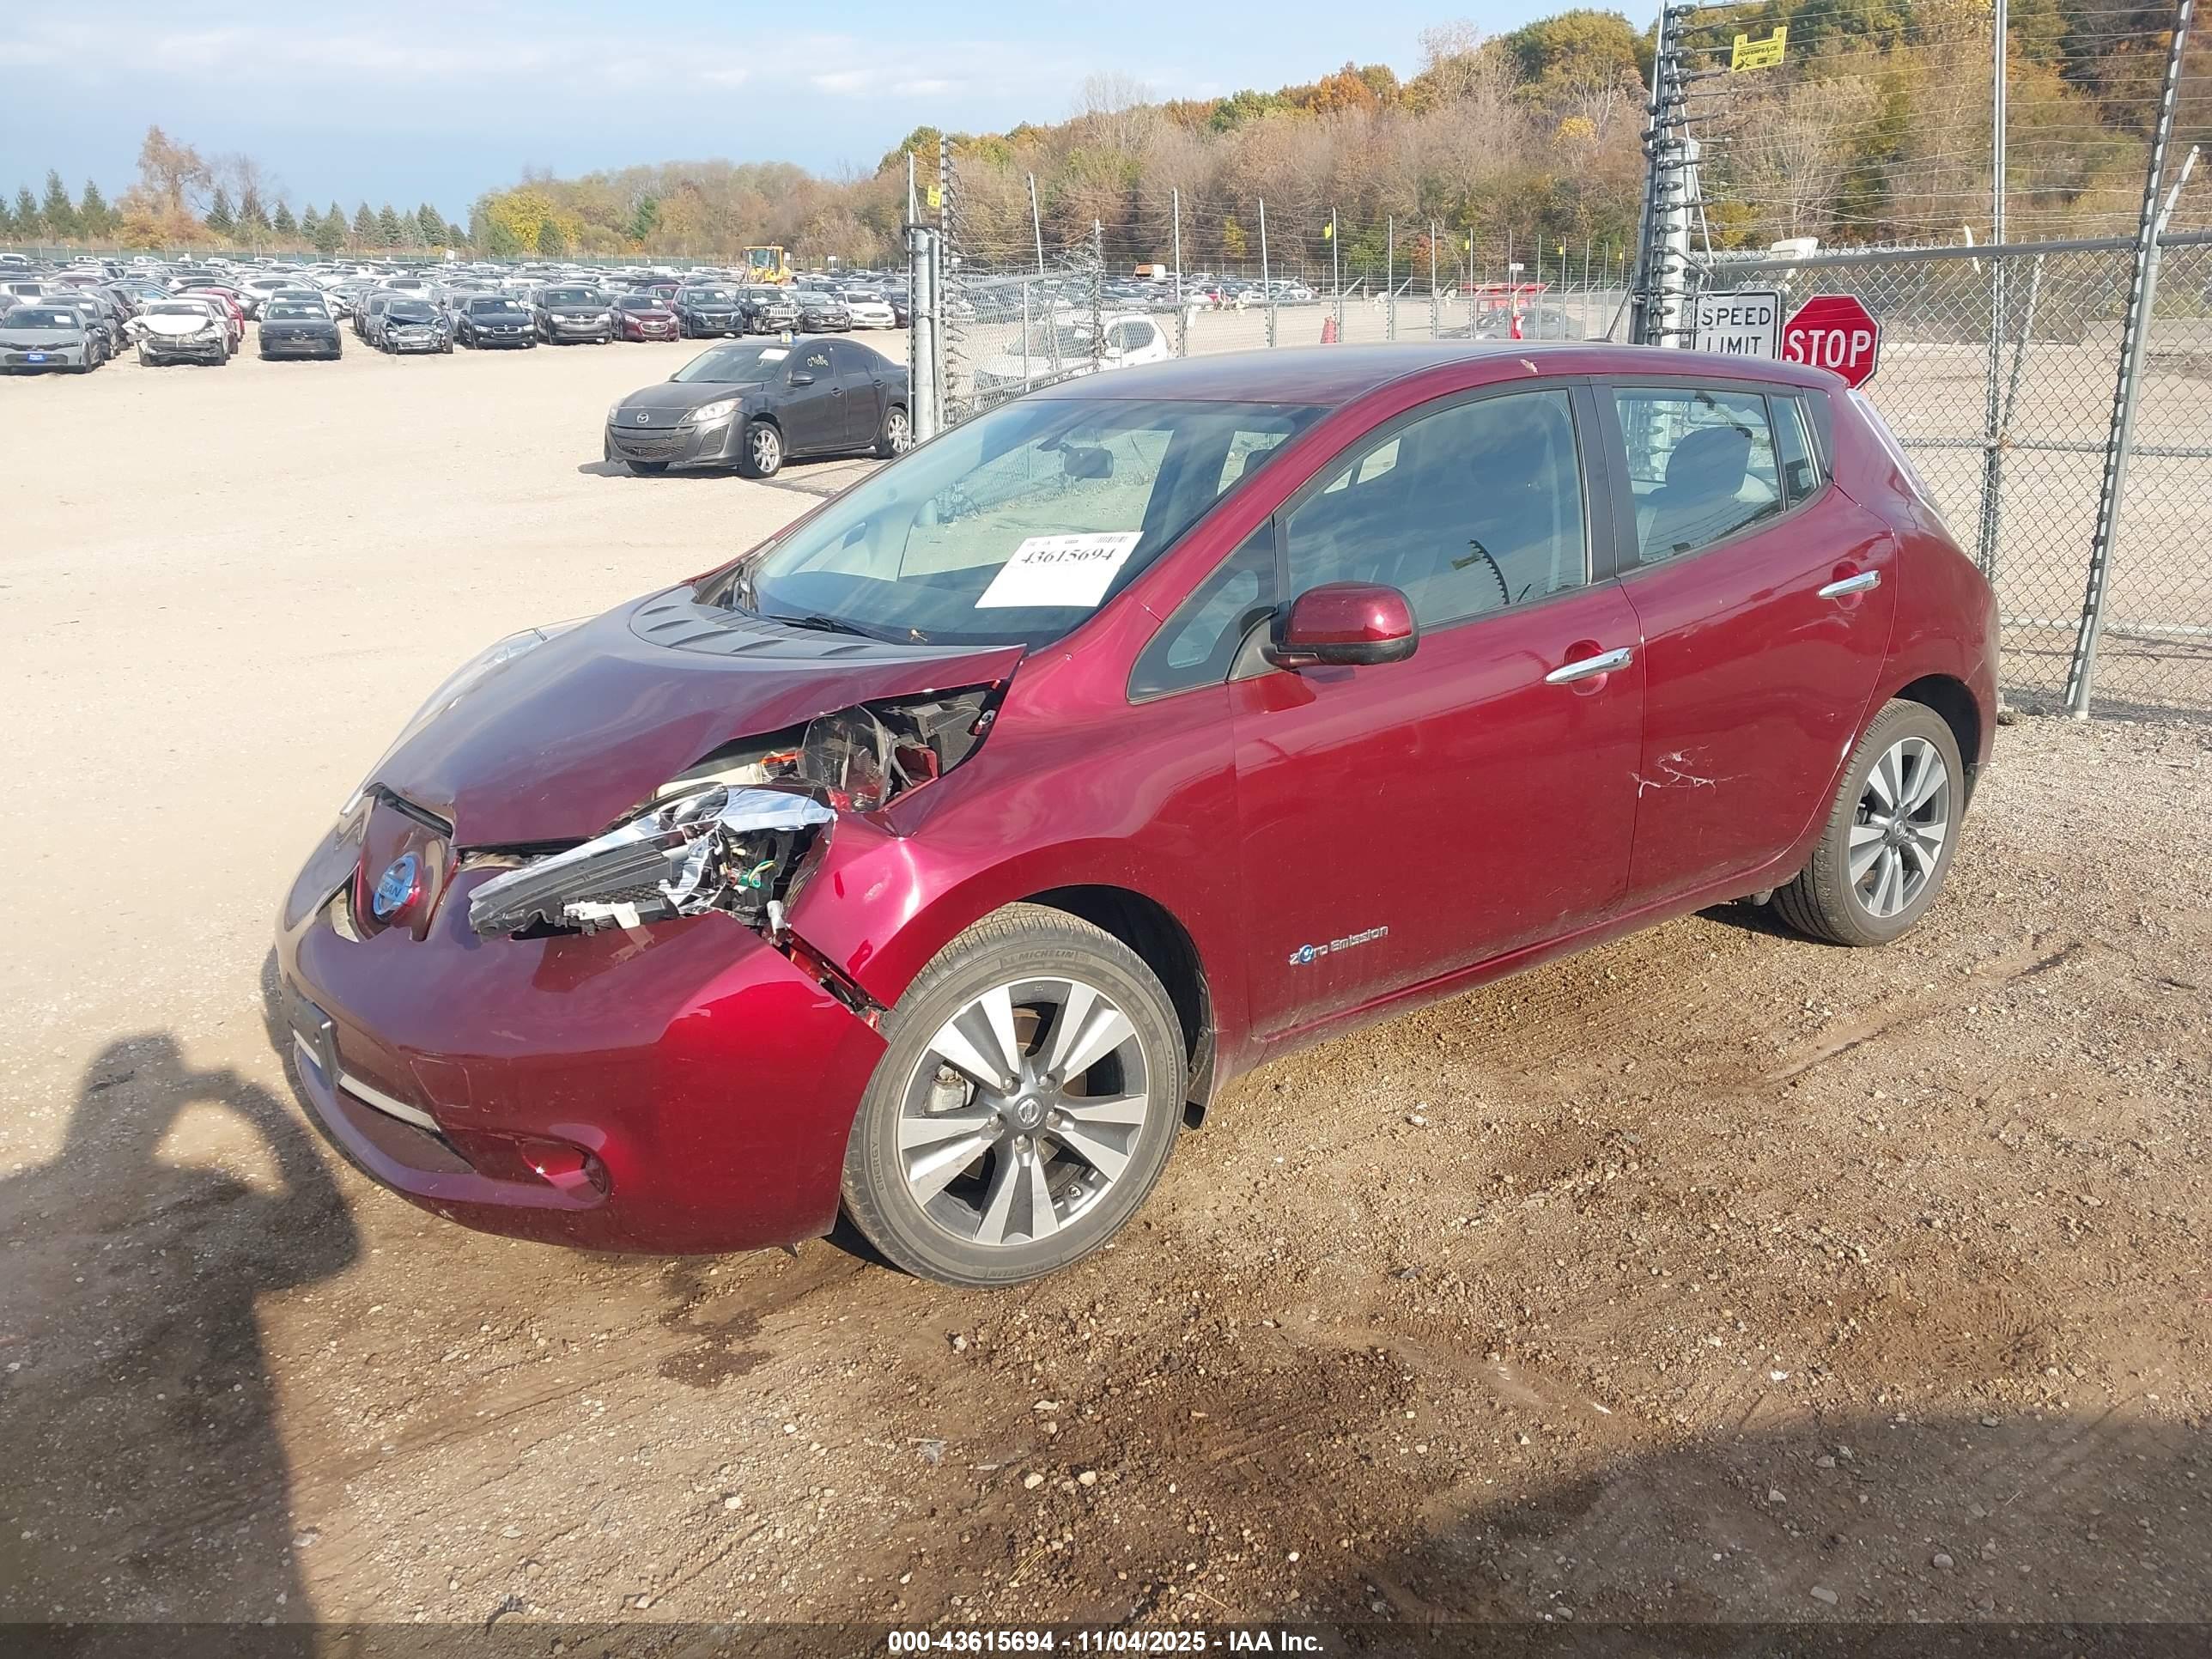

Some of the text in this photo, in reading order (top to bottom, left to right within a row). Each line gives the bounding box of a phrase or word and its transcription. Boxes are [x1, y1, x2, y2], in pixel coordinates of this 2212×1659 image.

[1701, 307, 1771, 326] SPEED
[1706, 336, 1762, 355] LIMIT
[1786, 329, 1871, 368] STOP
[1021, 548, 1116, 564] 43615694
[1289, 926, 1389, 965] Zero Emission
[1018, 951, 1074, 962] MICHELIN
[872, 1140, 884, 1191] ENERGY
